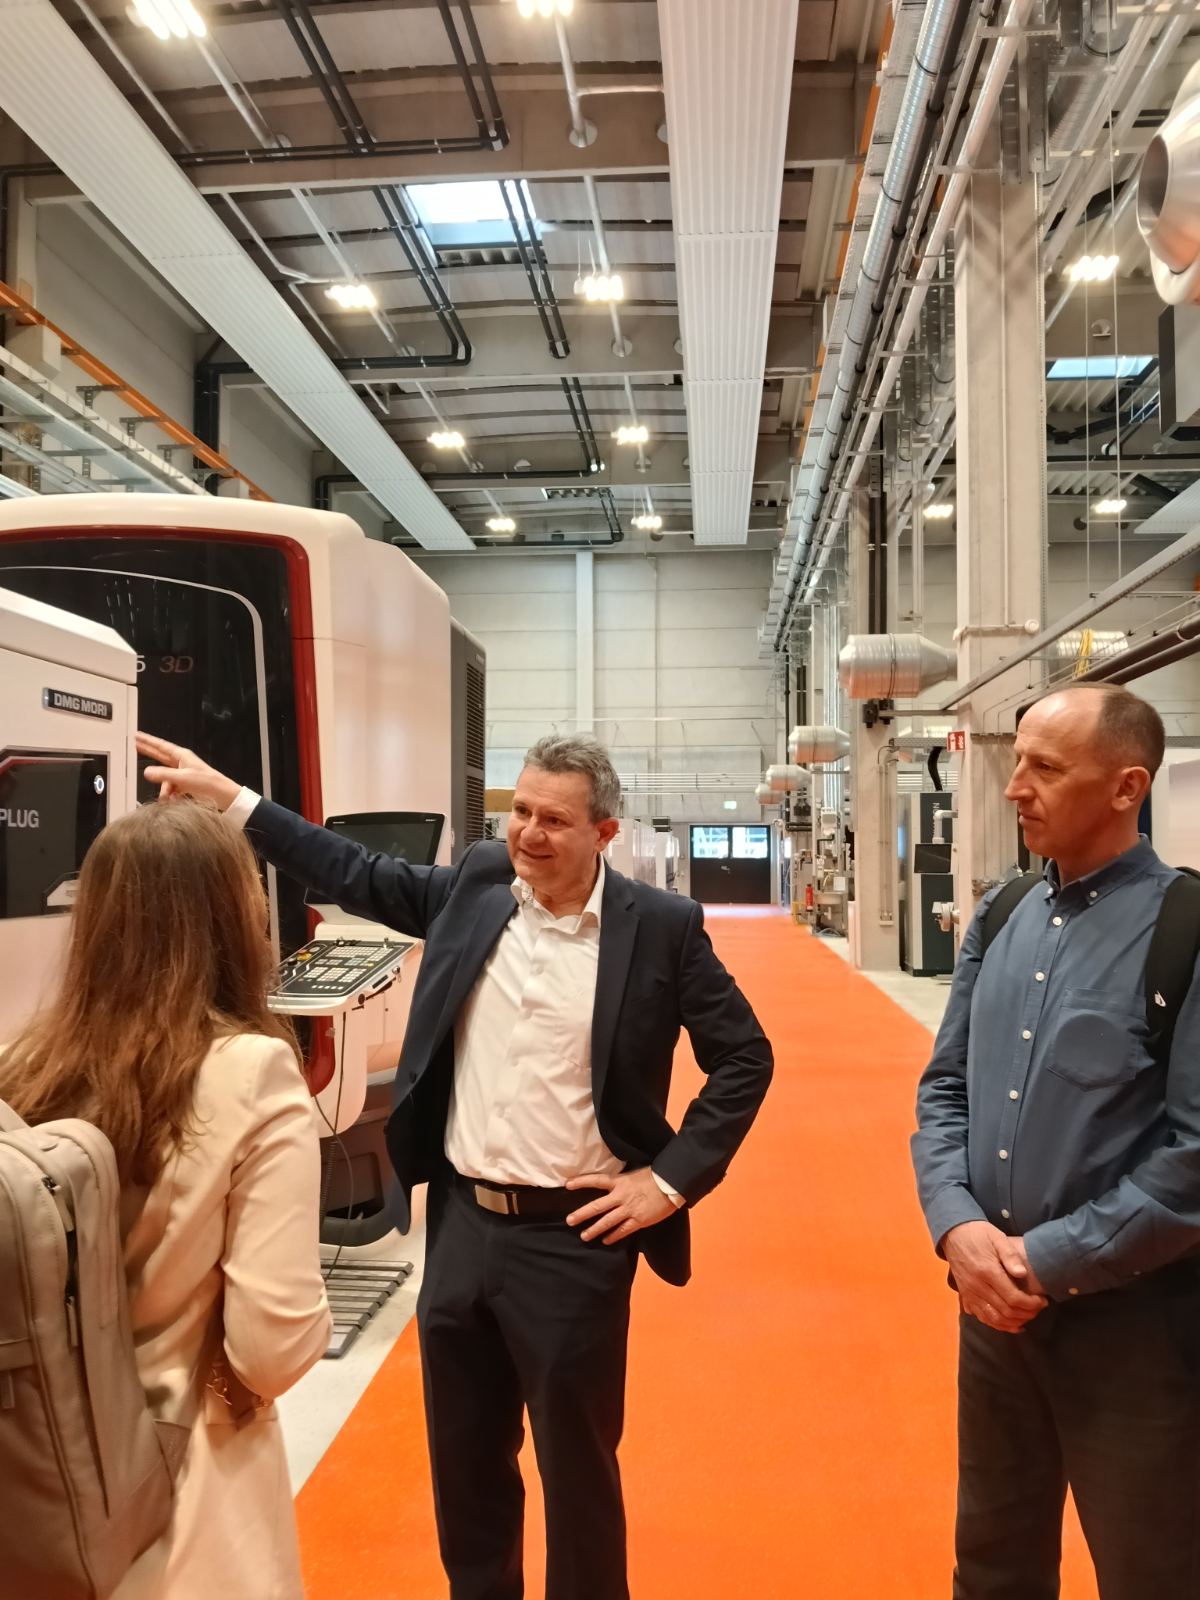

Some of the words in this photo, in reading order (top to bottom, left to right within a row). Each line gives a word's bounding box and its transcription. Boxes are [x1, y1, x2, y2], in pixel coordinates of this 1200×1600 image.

[159, 655, 194, 673] 3D
[53, 692, 81, 710] DMG
[81, 699, 108, 717] MORI
[0, 808, 40, 828] PLUG
